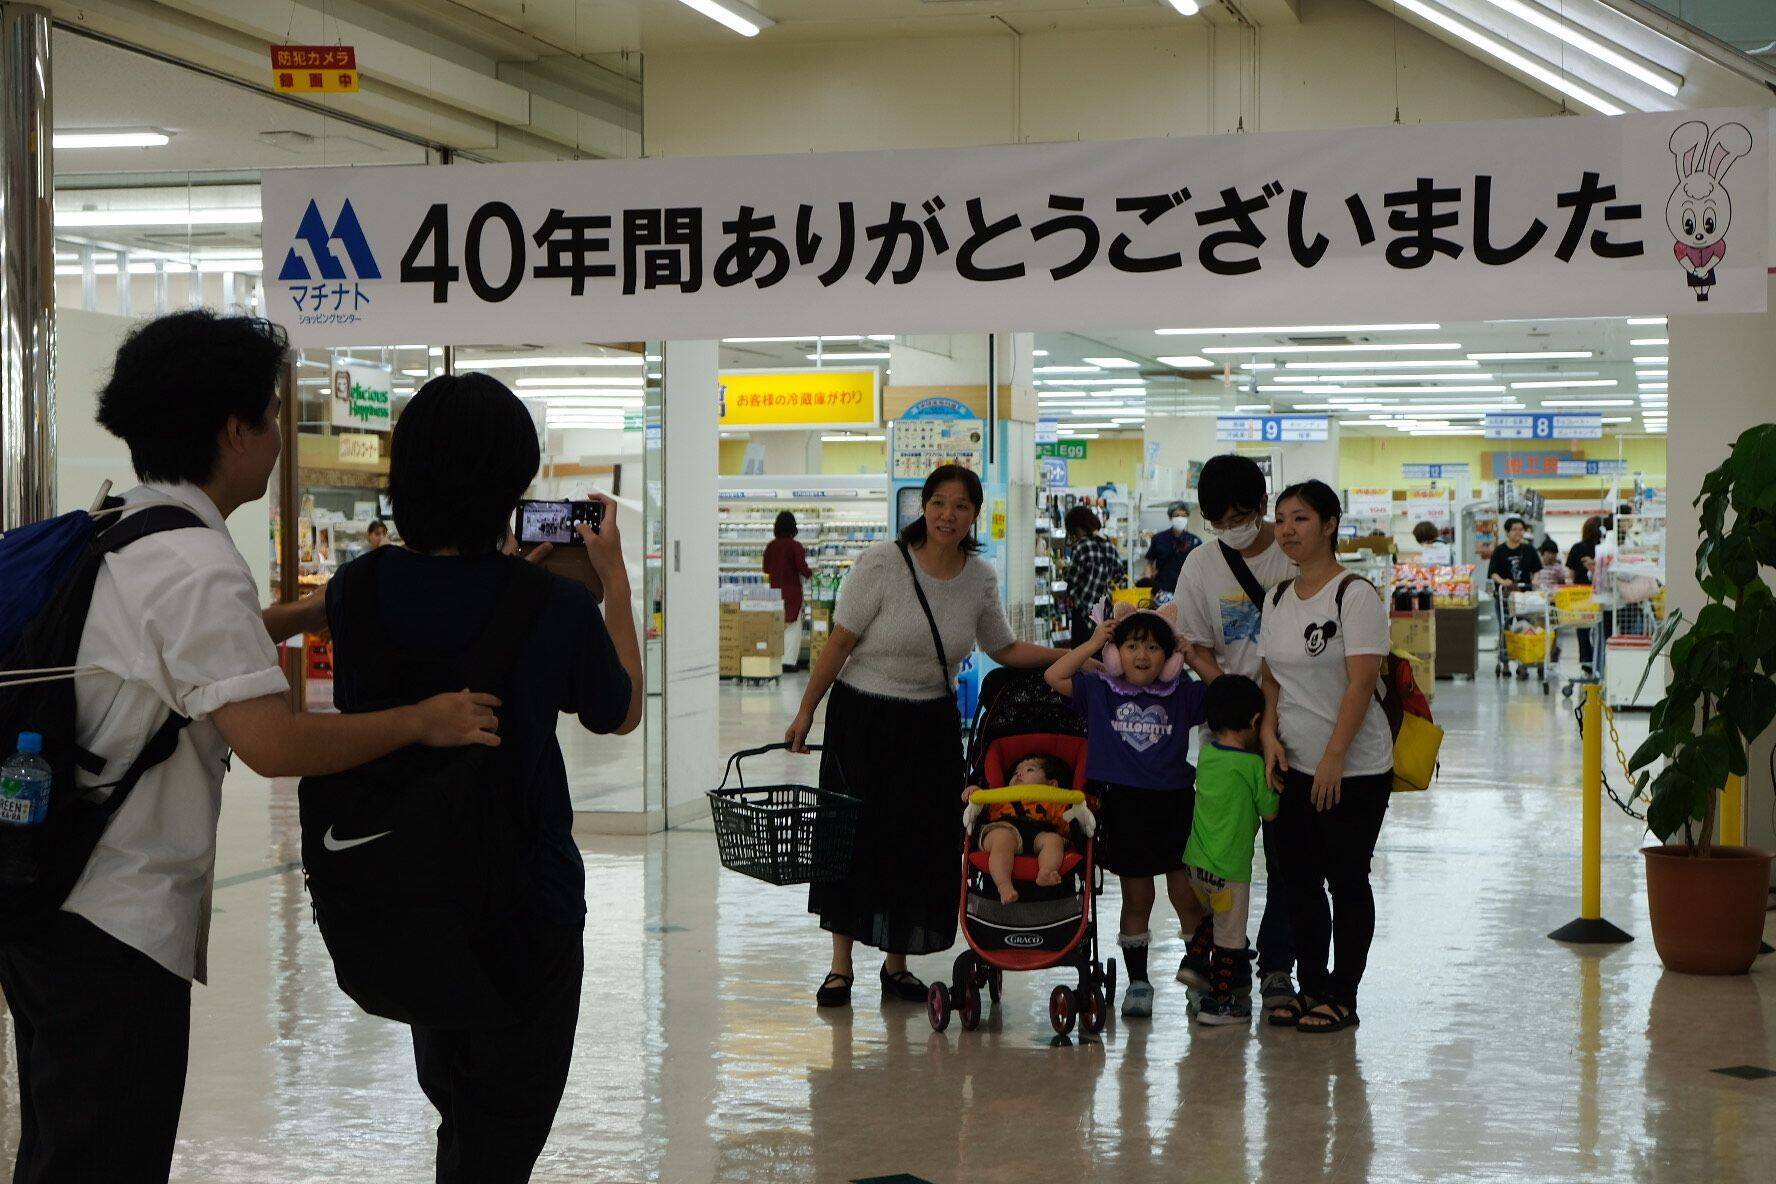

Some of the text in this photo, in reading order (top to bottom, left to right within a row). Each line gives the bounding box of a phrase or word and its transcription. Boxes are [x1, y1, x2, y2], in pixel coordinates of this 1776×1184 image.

[278, 51, 349, 66] 防犯カメラ
[280, 73, 352, 88] 録画中
[401, 171, 1645, 304] 40年間ありがとうございました
[289, 282, 370, 311] マチナト
[299, 313, 362, 325] ショッピングセンター
[1265, 420, 1279, 440] 9
[1536, 417, 1549, 437] 8
[1060, 445, 1083, 458] Egg
[1010, 936, 1040, 944] GRACO
